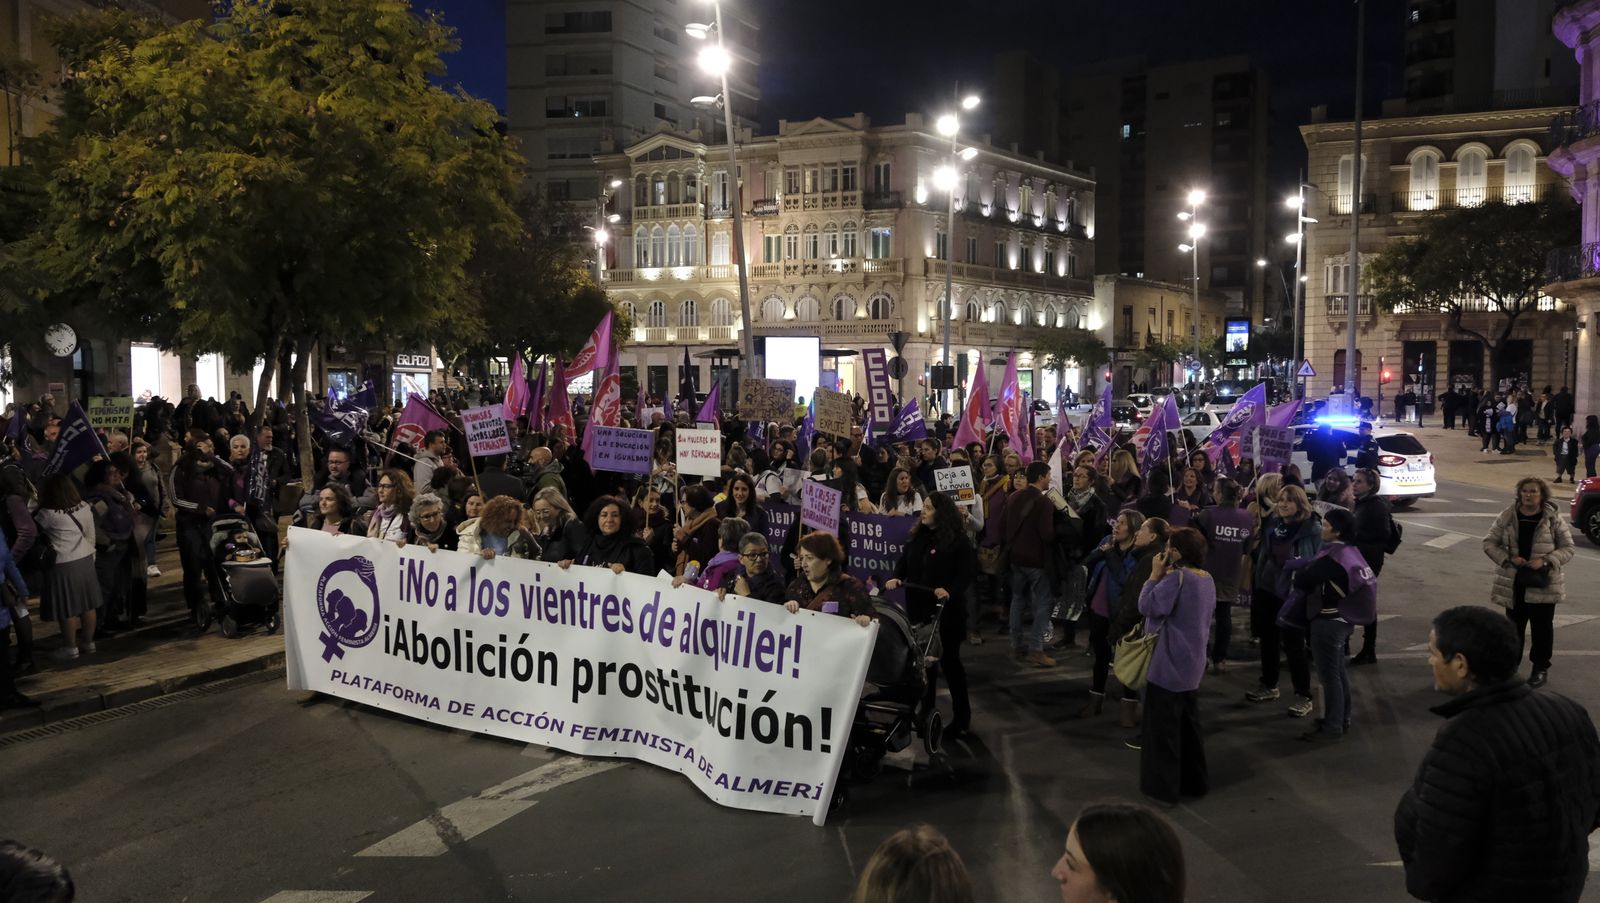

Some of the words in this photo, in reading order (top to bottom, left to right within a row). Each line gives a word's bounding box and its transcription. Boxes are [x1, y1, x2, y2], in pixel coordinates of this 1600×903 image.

[867, 352, 889, 422] CCOO
[90, 407, 130, 415] FEMINISMO
[105, 416, 130, 424] MATA
[937, 471, 956, 484] Deja
[805, 484, 813, 496] LA
[939, 482, 947, 490] tu
[950, 482, 970, 490] novio
[1216, 525, 1239, 537] UGT
[863, 538, 905, 555] Mujer
[399, 557, 439, 607] ¡No
[444, 574, 458, 612] a
[468, 566, 510, 617] los
[520, 573, 634, 634] vientres
[639, 591, 676, 648] de
[679, 602, 803, 679] alquiler!
[384, 614, 558, 687] ¡Abolición
[572, 657, 833, 754] prostitución!
[330, 669, 441, 710] PLATAFORMA
[447, 700, 476, 716] DE
[481, 711, 565, 734] ACCIÓN
[570, 724, 694, 763] FEMINISTA
[698, 755, 714, 779] DE
[714, 773, 824, 801] ALMERÍ
